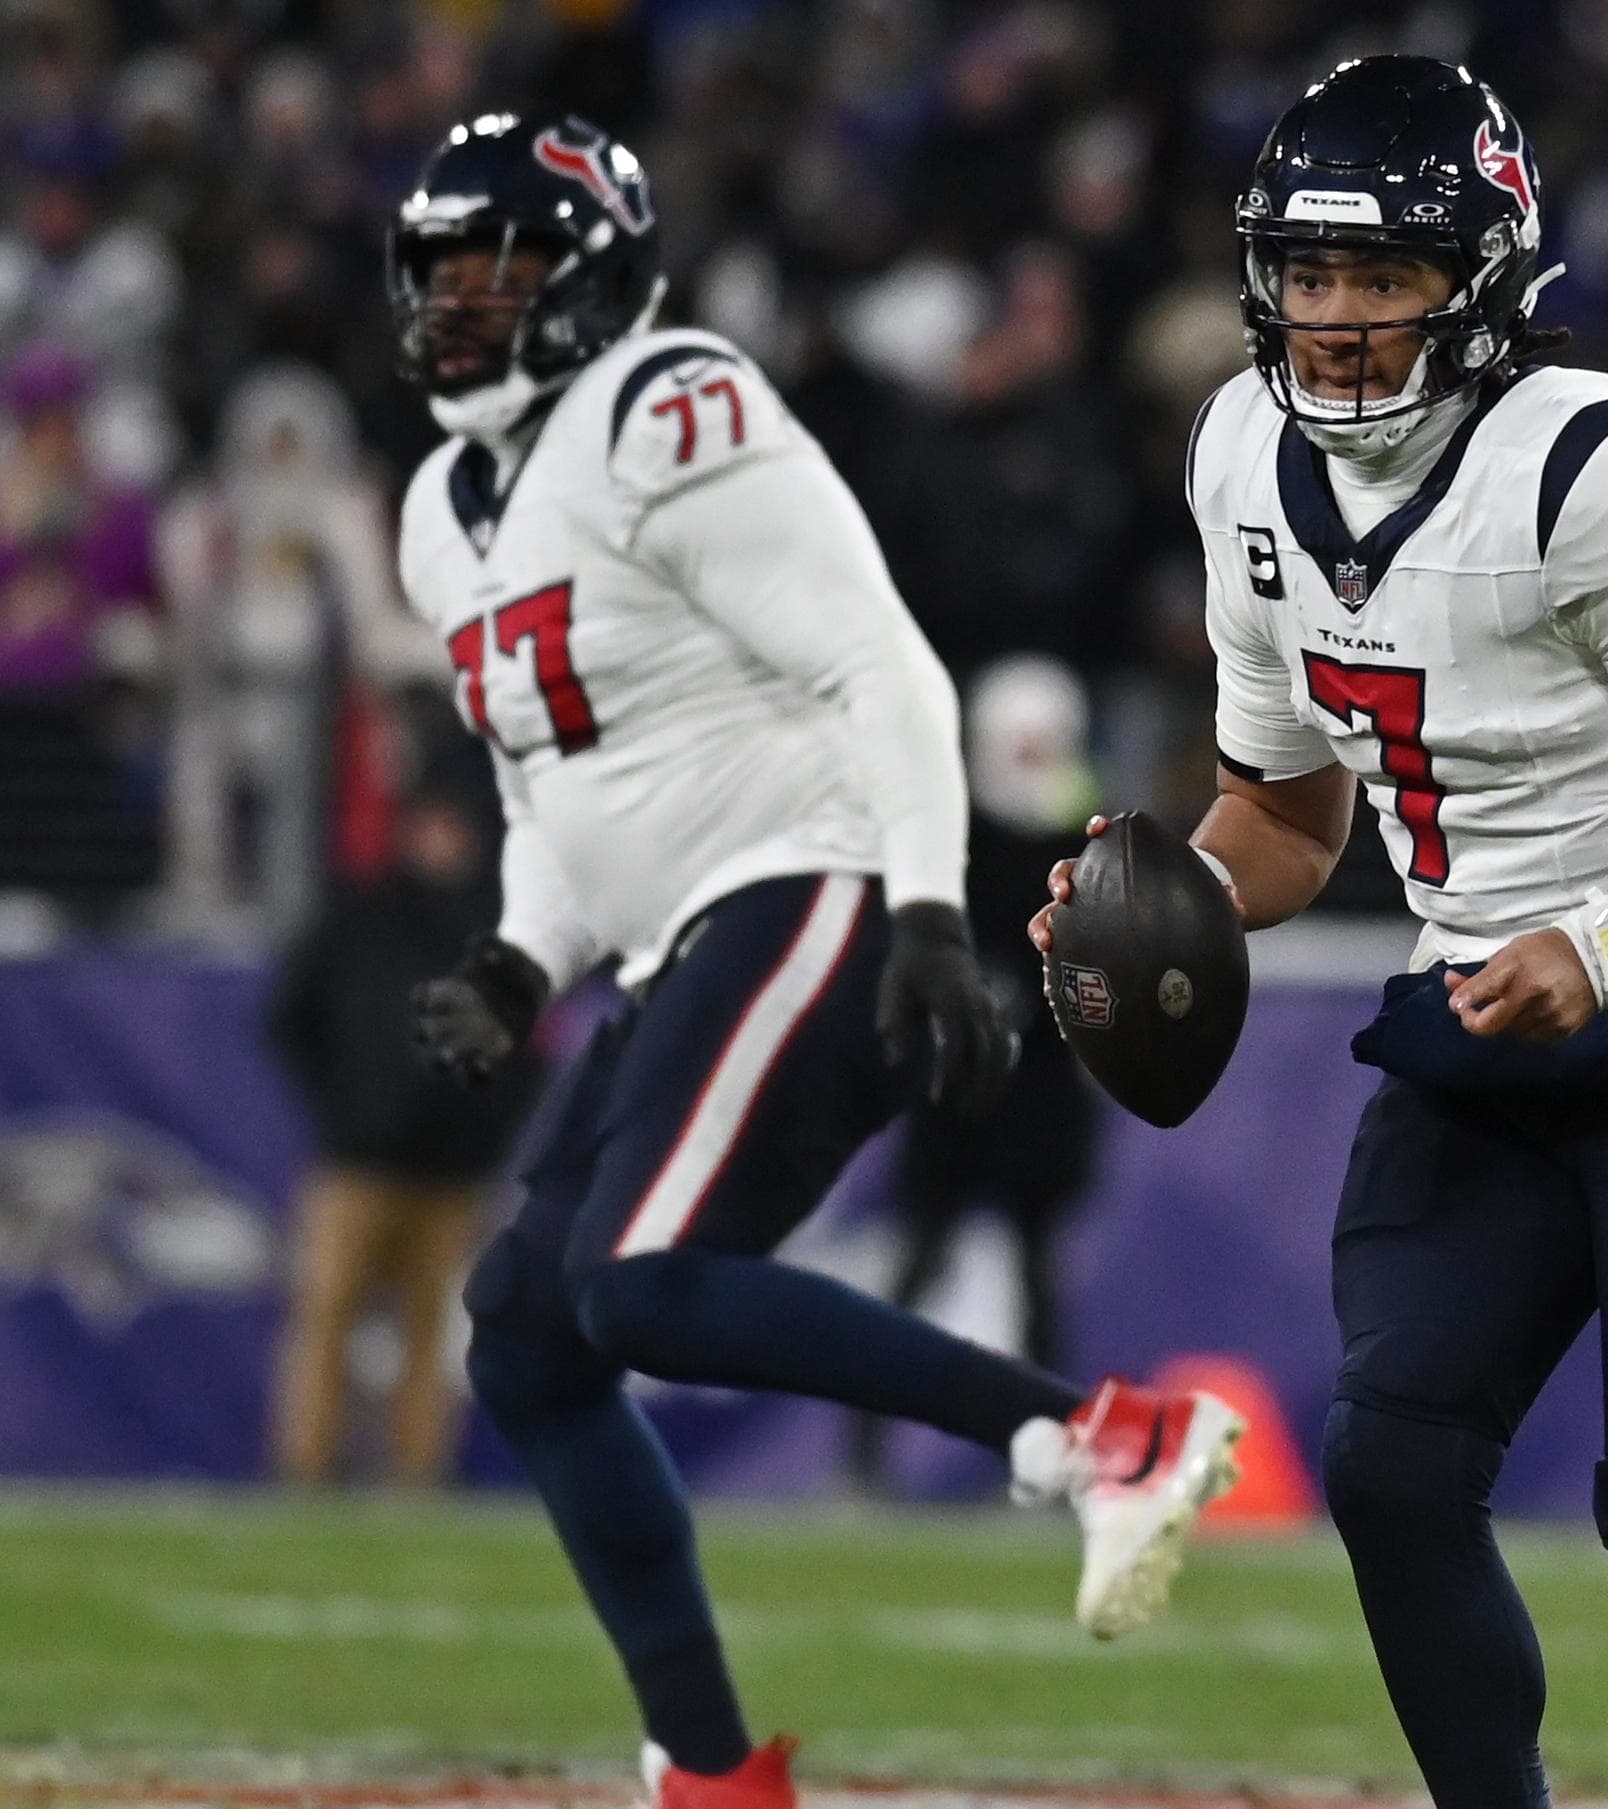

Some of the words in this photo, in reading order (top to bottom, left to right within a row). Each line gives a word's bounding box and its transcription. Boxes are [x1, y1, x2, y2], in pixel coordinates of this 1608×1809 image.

[1301, 197, 1361, 207] TEXANS
[650, 377, 745, 464] 77
[1239, 530, 1276, 581] C
[1340, 580, 1364, 600] NFL
[1316, 628, 1396, 653] TEXANS
[446, 576, 599, 758] 77
[1300, 648, 1450, 888] 7
[1080, 974, 1109, 1023] NFL
